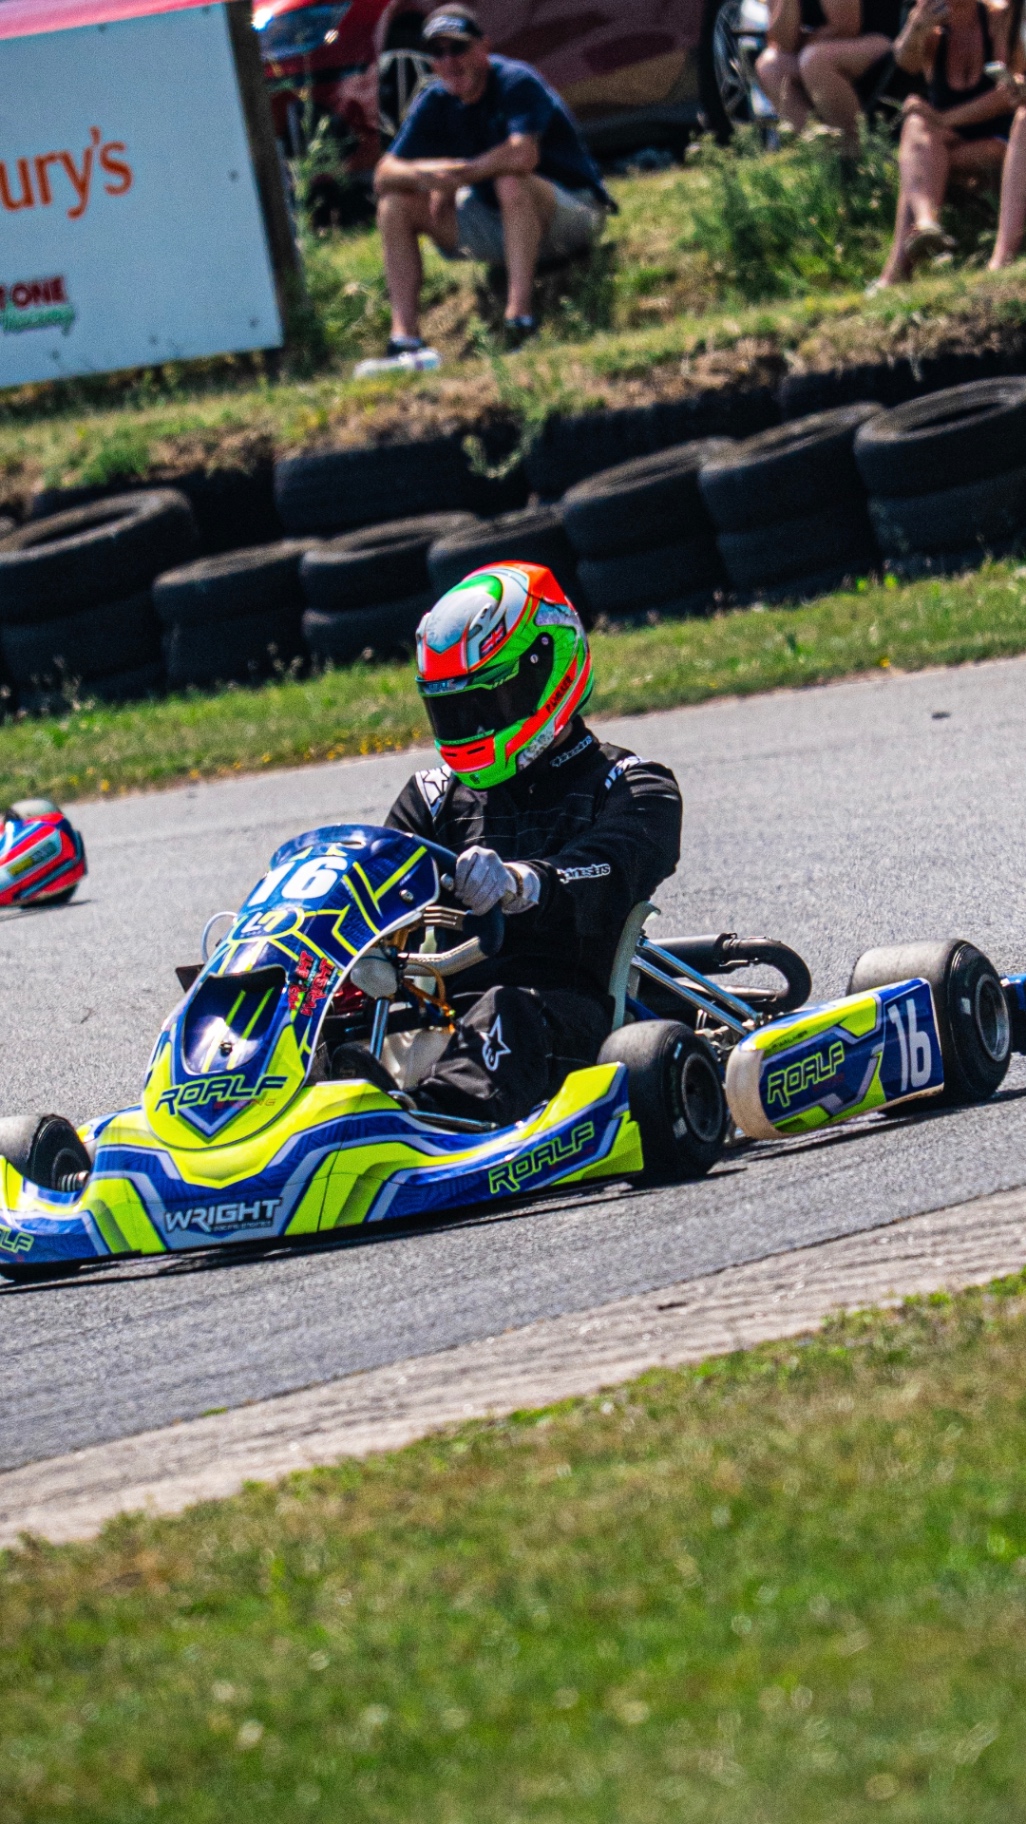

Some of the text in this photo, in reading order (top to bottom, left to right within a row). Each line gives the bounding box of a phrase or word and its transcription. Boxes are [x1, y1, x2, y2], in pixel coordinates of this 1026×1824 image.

[10, 274, 69, 311] ONE
[248, 856, 348, 907] 16
[887, 998, 932, 1092] 16
[154, 1075, 289, 1116] ROALF
[767, 1041, 845, 1107] ROALF
[488, 1121, 595, 1194] ROALF
[164, 1199, 282, 1234] WRIGHT
